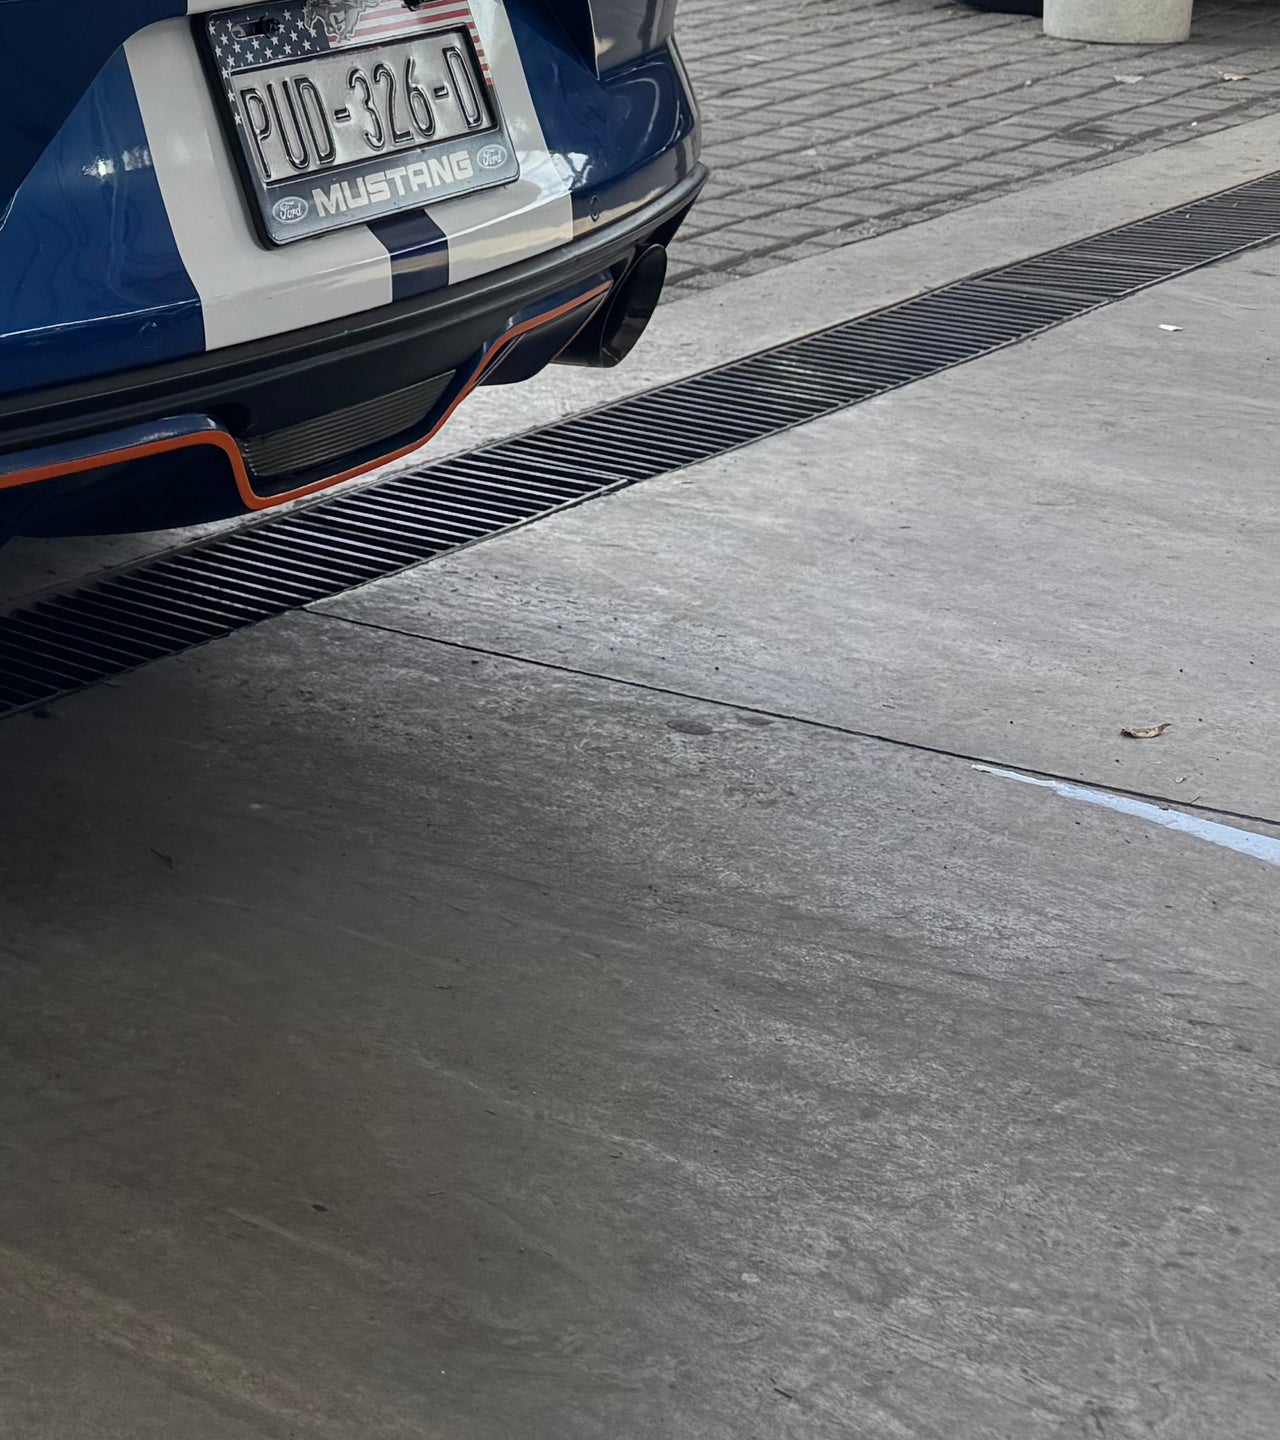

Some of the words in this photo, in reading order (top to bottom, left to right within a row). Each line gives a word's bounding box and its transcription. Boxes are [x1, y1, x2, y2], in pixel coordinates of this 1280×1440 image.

[240, 45, 486, 180] PUD-326-D
[277, 200, 304, 220] Ford
[311, 150, 474, 217] MUSTANG
[481, 147, 502, 166] Ford
